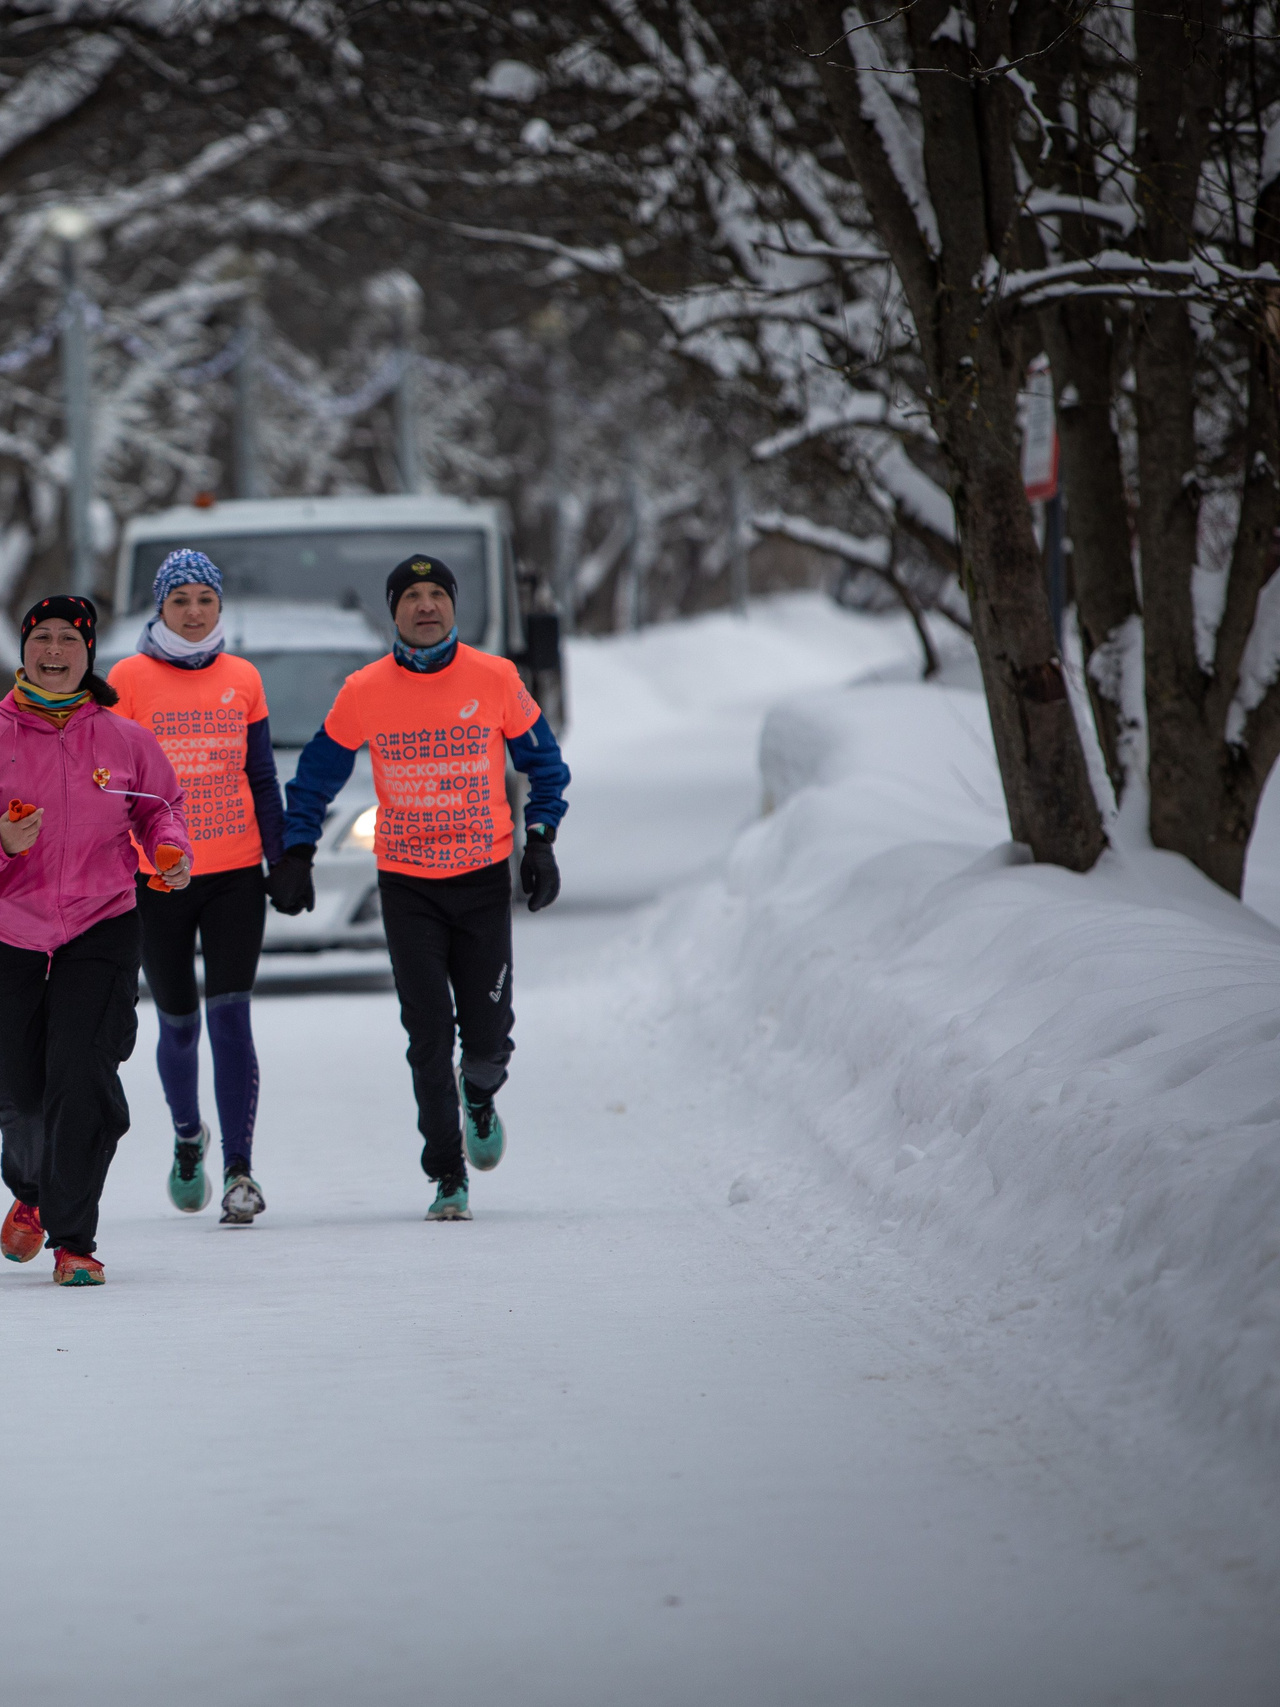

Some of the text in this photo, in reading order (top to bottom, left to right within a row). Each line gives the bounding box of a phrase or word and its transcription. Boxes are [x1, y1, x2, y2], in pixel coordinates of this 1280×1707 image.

[167, 751, 196, 763] ОЛУ
[177, 763, 224, 775] РАФОН
[382, 756, 490, 778] МОСКОВСКИЙ
[384, 779, 423, 793] ПОЛУ
